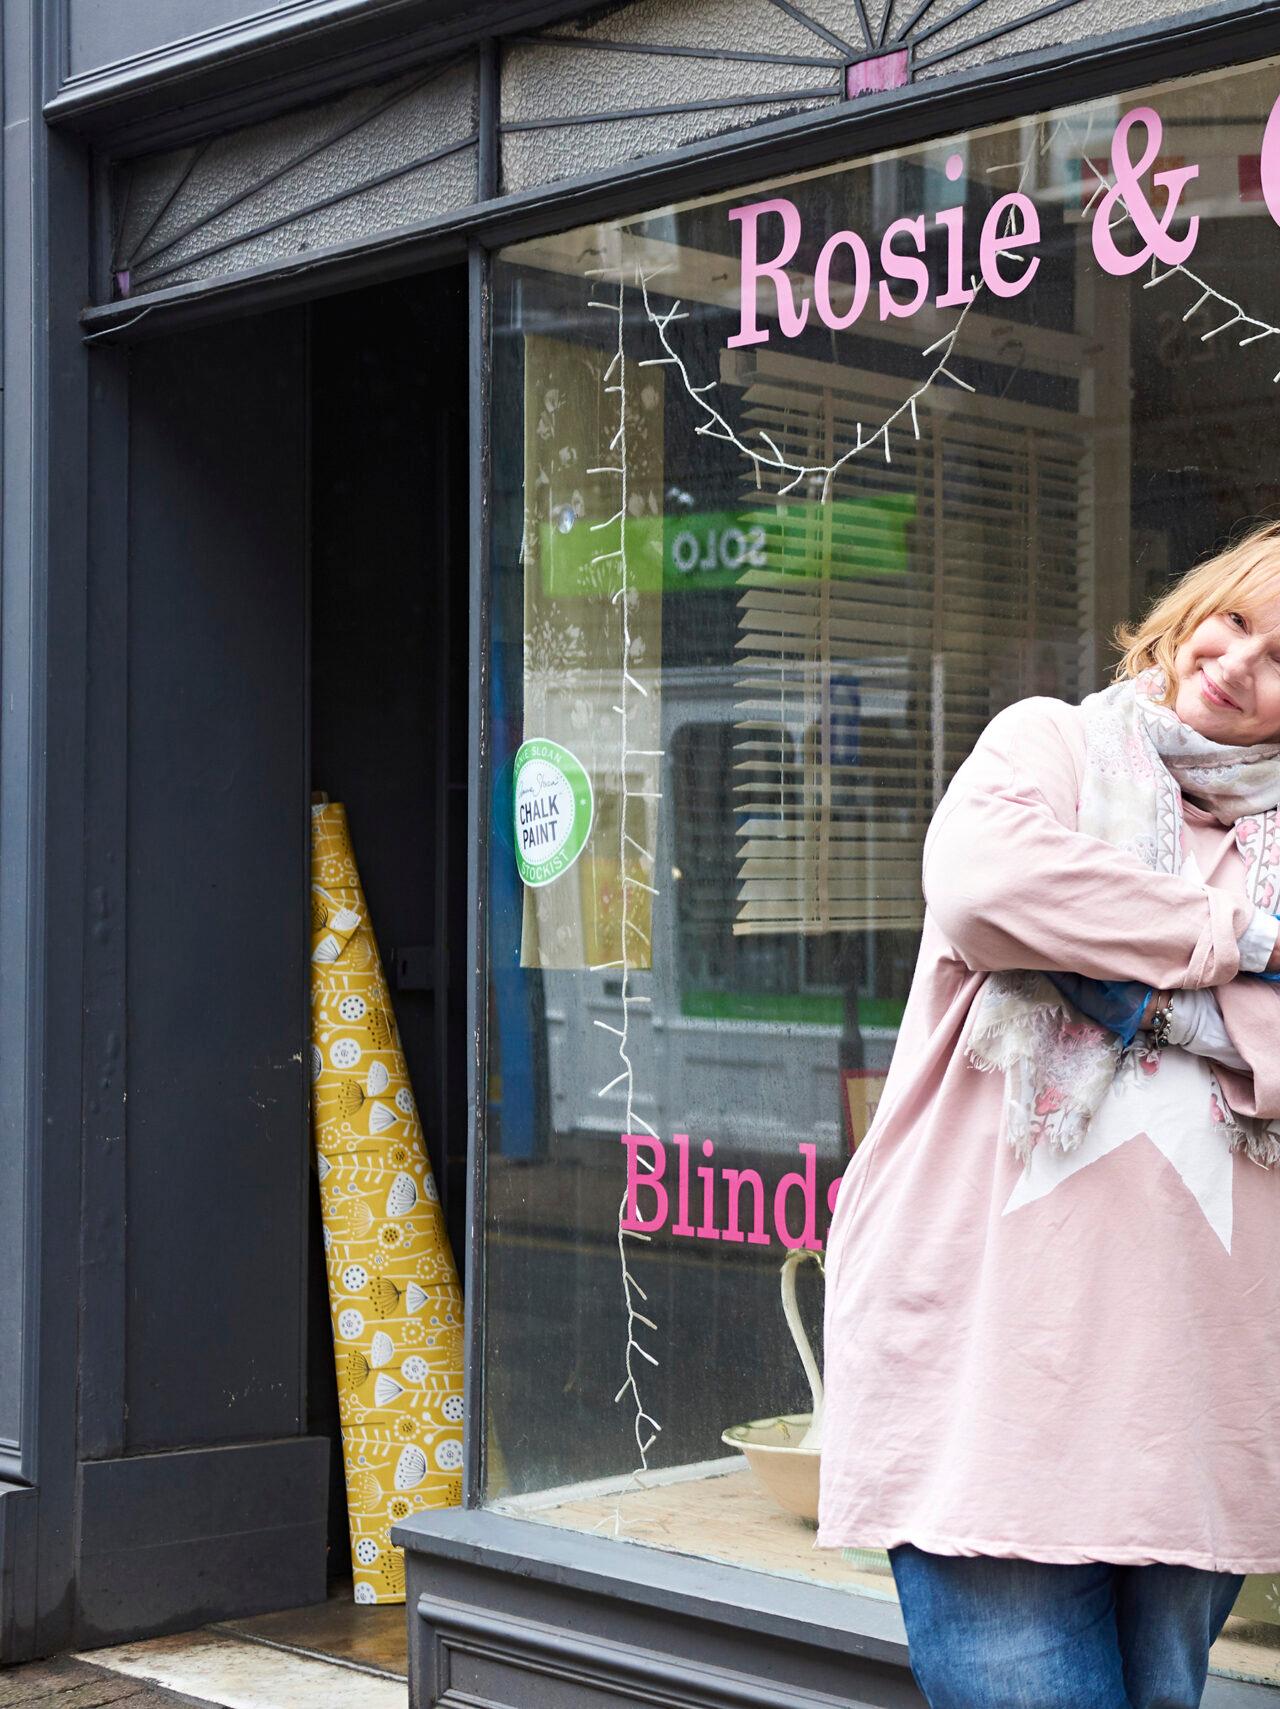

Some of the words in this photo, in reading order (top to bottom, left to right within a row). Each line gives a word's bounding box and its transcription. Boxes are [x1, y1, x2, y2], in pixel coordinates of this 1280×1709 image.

[728, 155, 1041, 348] Rosie
[1092, 107, 1199, 276] &
[531, 746, 562, 764] SLOAN
[520, 795, 559, 825] CHALK
[523, 821, 558, 849] PAINT
[521, 851, 570, 880] STOCKIST
